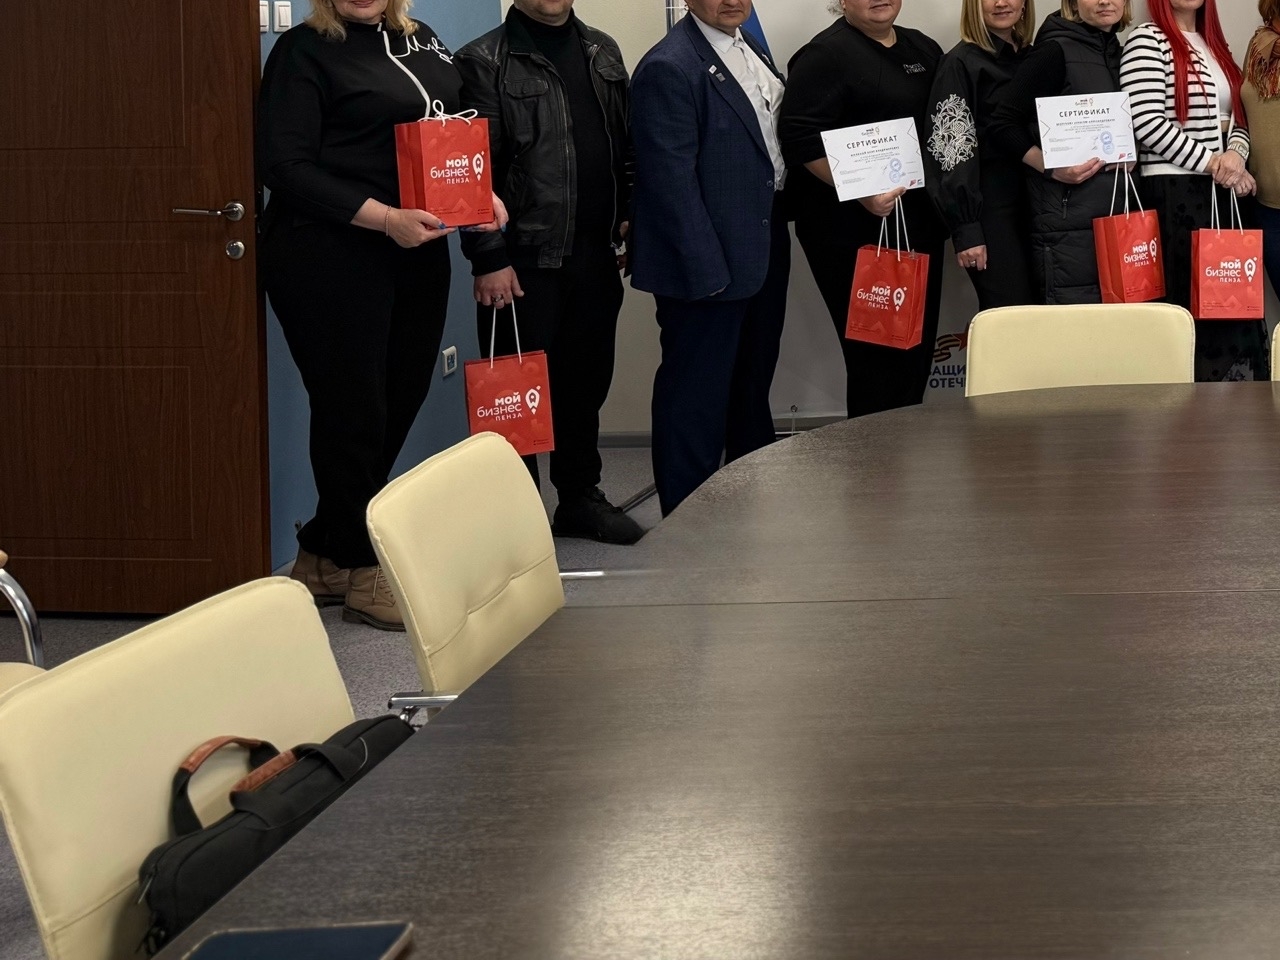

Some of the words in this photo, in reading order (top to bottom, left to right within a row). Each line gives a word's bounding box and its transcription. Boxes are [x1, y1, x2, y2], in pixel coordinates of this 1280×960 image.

[1059, 107, 1110, 118] СЕРТИФИКАТ
[846, 135, 898, 150] СЕРТИФИКАТ
[430, 166, 470, 179] бизнес
[1123, 251, 1149, 264] бизнес
[1205, 266, 1241, 277] бизнес
[856, 288, 890, 305] бизнес
[477, 403, 522, 418] бизнес
